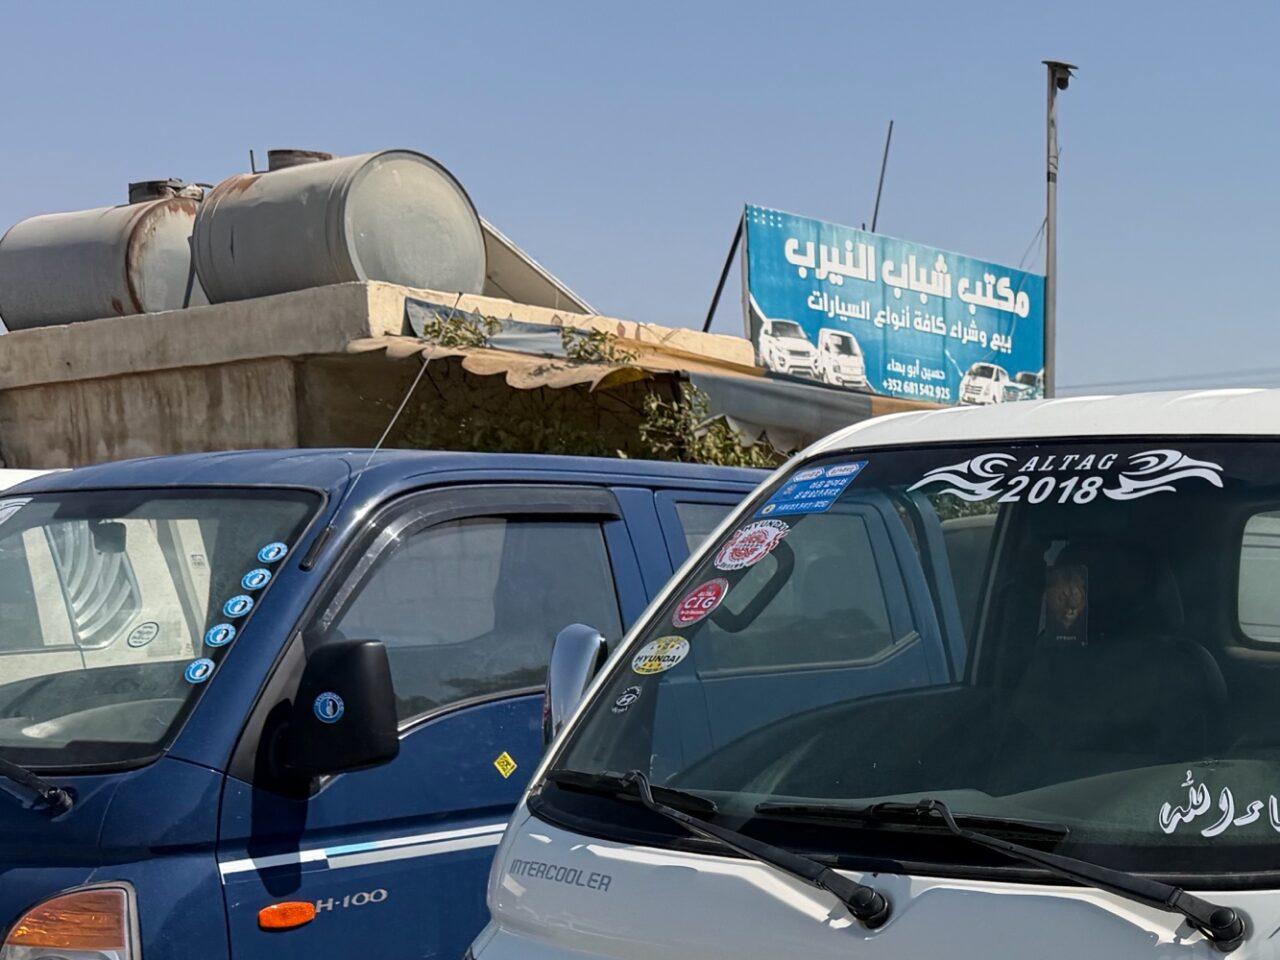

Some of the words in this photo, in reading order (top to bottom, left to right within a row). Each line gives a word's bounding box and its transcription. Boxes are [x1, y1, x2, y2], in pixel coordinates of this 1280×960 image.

[785, 238, 876, 286] النيرب
[882, 254, 952, 304] شباب
[807, 290, 871, 322] السيارات
[958, 272, 1030, 318] مكتب
[873, 305, 910, 329] أنواع
[913, 310, 947, 335] كافة
[949, 319, 987, 348] وشراء
[990, 332, 1012, 354] بيع
[1018, 453, 1119, 472] ALTAG
[997, 475, 1104, 504] 2018
[634, 655, 681, 663] HYUNDAI
[509, 858, 613, 892] INTERCOOLER
[316, 888, 388, 913] H-100
